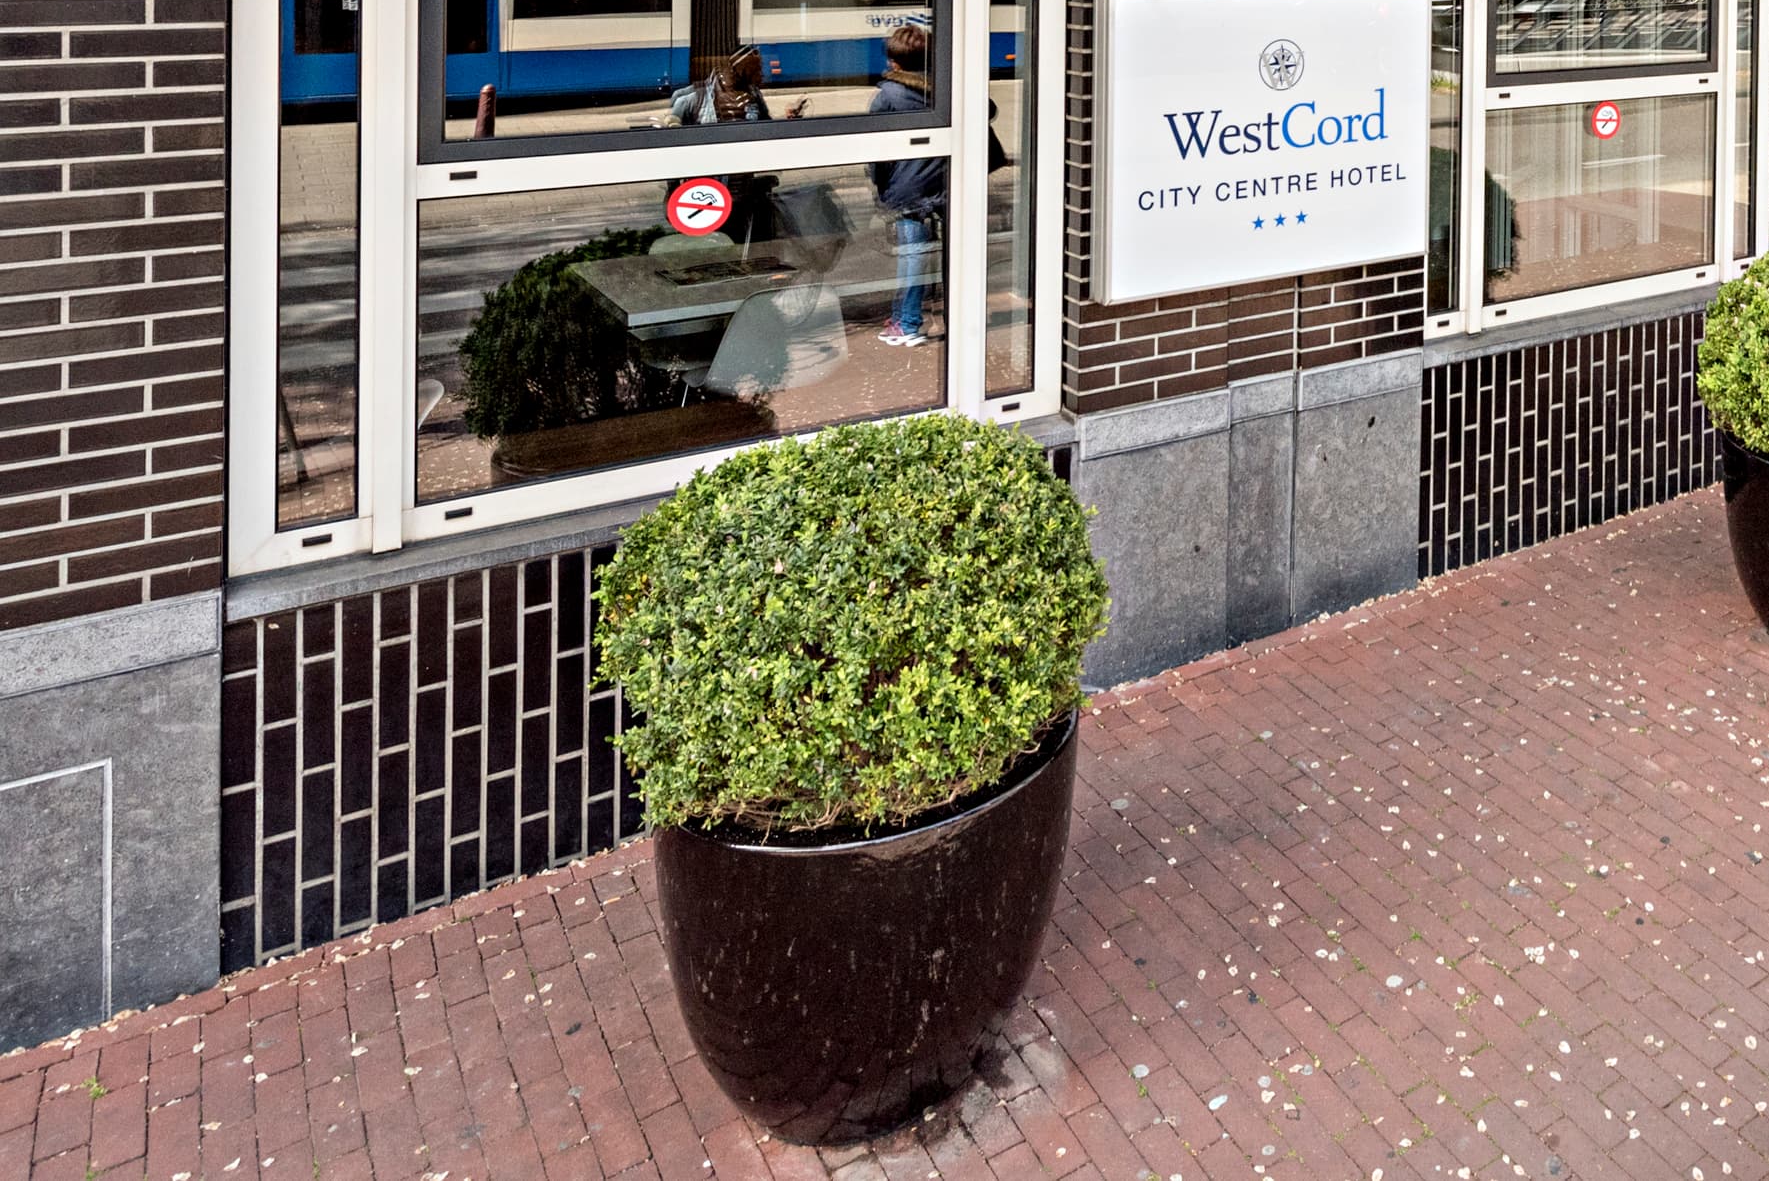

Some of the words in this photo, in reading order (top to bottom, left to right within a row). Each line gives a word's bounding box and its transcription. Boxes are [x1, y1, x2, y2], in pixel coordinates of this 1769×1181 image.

[1163, 87, 1389, 161] WestCord
[1138, 185, 1202, 211] CITY
[1215, 172, 1319, 202] CENTRE
[1330, 162, 1407, 188] HOTEL
